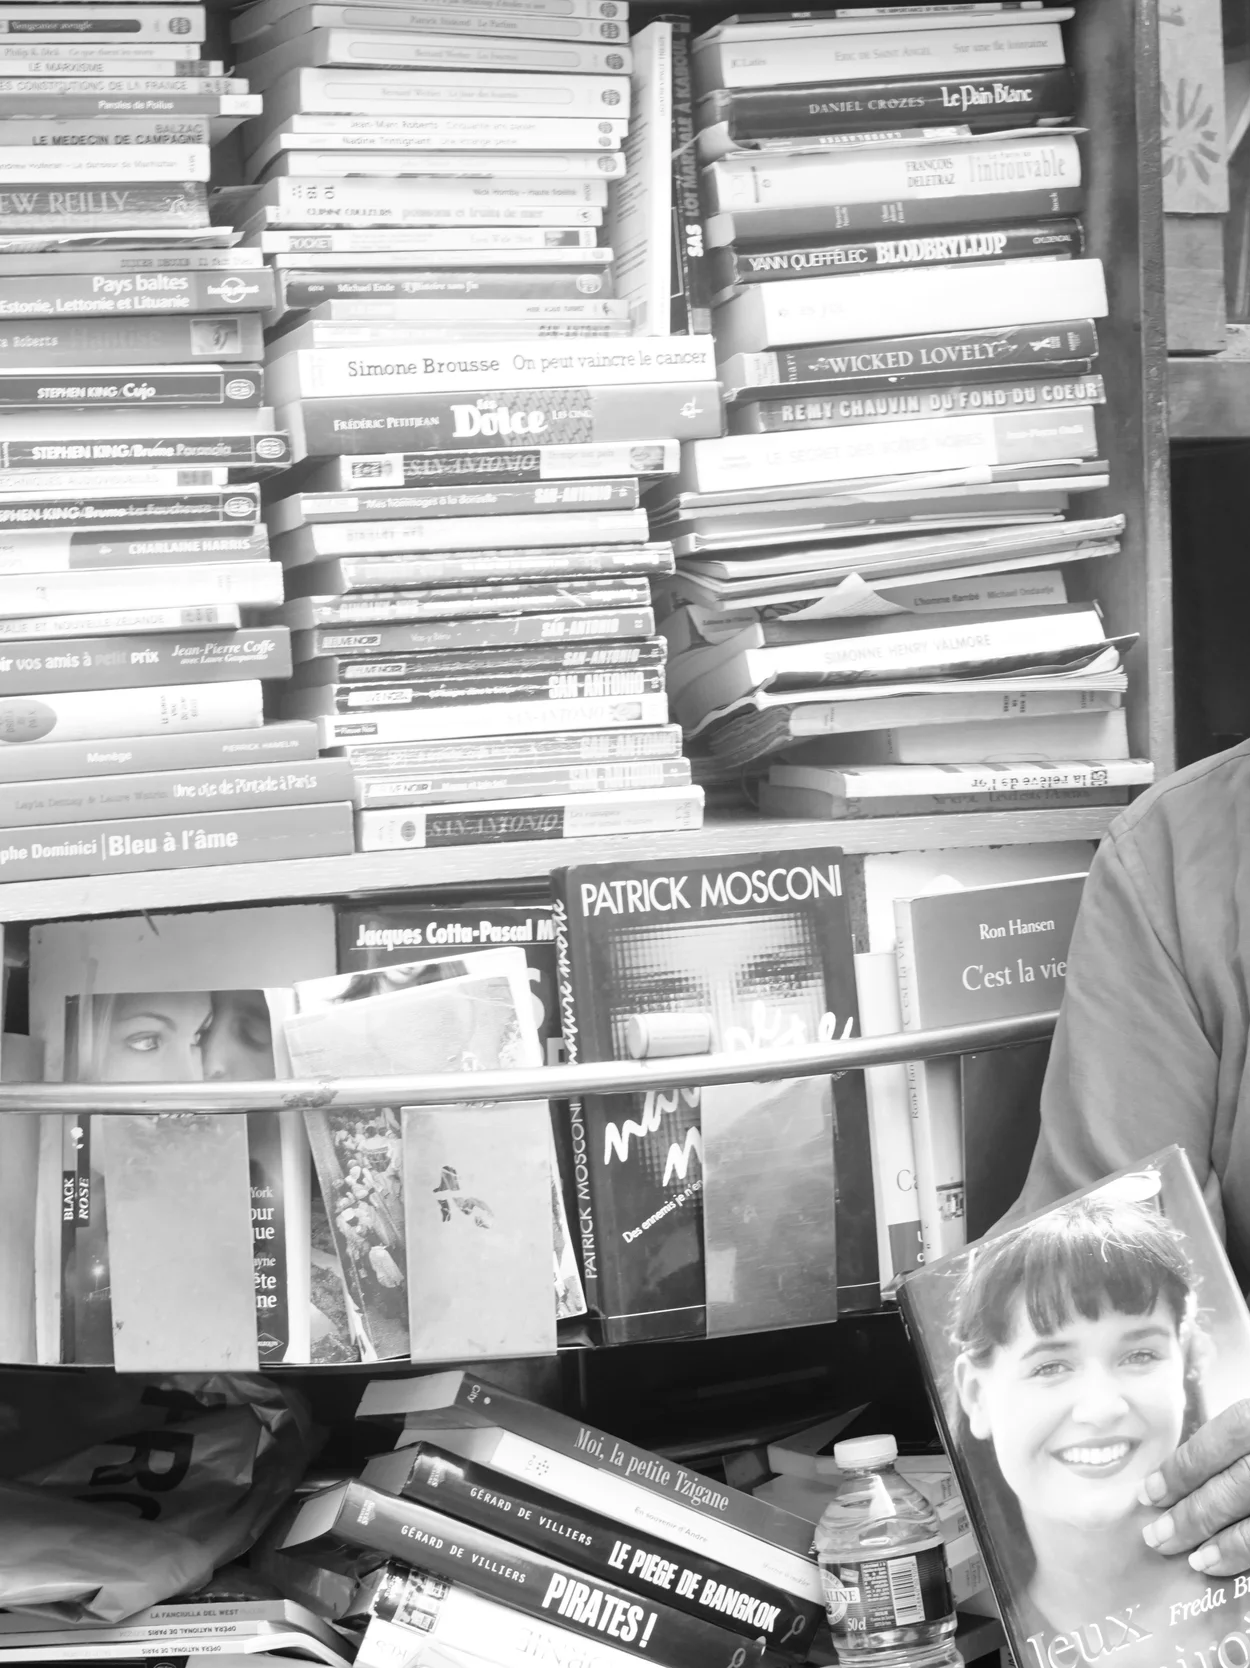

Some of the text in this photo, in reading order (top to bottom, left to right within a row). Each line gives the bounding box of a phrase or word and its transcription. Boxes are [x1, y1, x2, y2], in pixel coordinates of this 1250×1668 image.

[28, 62, 104, 72] LE MARXISME
[17, 81, 188, 92] CONSTITUTIONS DE LA FRANCE
[808, 81, 1034, 115] DANIEL CROZES Le Pain Blanc
[98, 100, 174, 110] Paroles de Poilus
[32, 134, 204, 146] LE MEDECIN DE CAMPAGNE
[155, 124, 203, 134] BALZAC
[672, 37, 705, 258] SAS LOI KABOUL
[968, 149, 1067, 185] l'introuvable
[50, 191, 130, 214] REILLY
[748, 255, 790, 272] YANN
[790, 248, 869, 269] QUEFFÉLEC
[875, 233, 1008, 265] BLODBRYLLUP
[92, 274, 189, 294] Pays baltes
[56, 297, 114, 312] Lettonie
[116, 298, 132, 310] et
[134, 295, 190, 309] Lituanie
[347, 349, 708, 378] Simone Brousse On peut vaincre le cancer
[828, 343, 999, 375] WICKED LOVELY
[37, 386, 87, 399] STEPHEN
[781, 381, 1099, 423] REMY CHAUVIN DU FOND DU COEUR
[450, 404, 549, 439] Dolce
[32, 445, 91, 460] STEPHEN
[128, 539, 250, 556] CHARLAINE HARRIS
[35, 618, 114, 633] ET NOUVELLE
[16, 648, 160, 670] vos amis à prix
[171, 639, 276, 658] Jean-Pierre Coffe
[823, 634, 992, 666] SIMONNE HENRY VALMORE
[172, 783, 196, 799] Une
[219, 780, 234, 795] de
[288, 774, 318, 790] Paris
[1001, 777, 1019, 790] de
[1023, 775, 1069, 789] relève
[1073, 774, 1087, 787] la
[32, 829, 239, 859] Dominici Bleu à l'âme
[580, 864, 844, 917] PATRICK MOSCONI
[356, 922, 422, 951] Jacques
[426, 918, 534, 945] Cotta-Pascal
[979, 918, 1056, 940] Ron Hansen
[551, 898, 579, 1066] nature morte
[961, 956, 1068, 992] C'est la vie
[63, 1177, 75, 1221] BLACK
[77, 1176, 91, 1221] ROSE
[250, 1186, 274, 1199] York
[569, 1101, 597, 1280] PATRICK MOSCONI
[622, 1227, 643, 1244] Des
[641, 1200, 677, 1230] ennemis
[674, 1194, 686, 1207] je
[466, 1384, 481, 1404] City
[573, 1427, 730, 1513] Moi, la petite Tzigane
[469, 1486, 593, 1548] GÉRARD DE VILLIERS
[400, 1524, 528, 1584] GÉRARD DE VILLIERS
[608, 1540, 632, 1570] LE
[675, 1568, 703, 1600] DE
[699, 1579, 781, 1634] BANGKOK
[161, 1610, 201, 1619] FANCIULLA
[203, 1609, 217, 1618] DEL
[219, 1608, 239, 1617] WEST
[1168, 1587, 1227, 1627] Freda
[215, 1625, 236, 1633] OPÉRA
[847, 1617, 858, 1631] 50
[1026, 1603, 1154, 1668] Jeux
